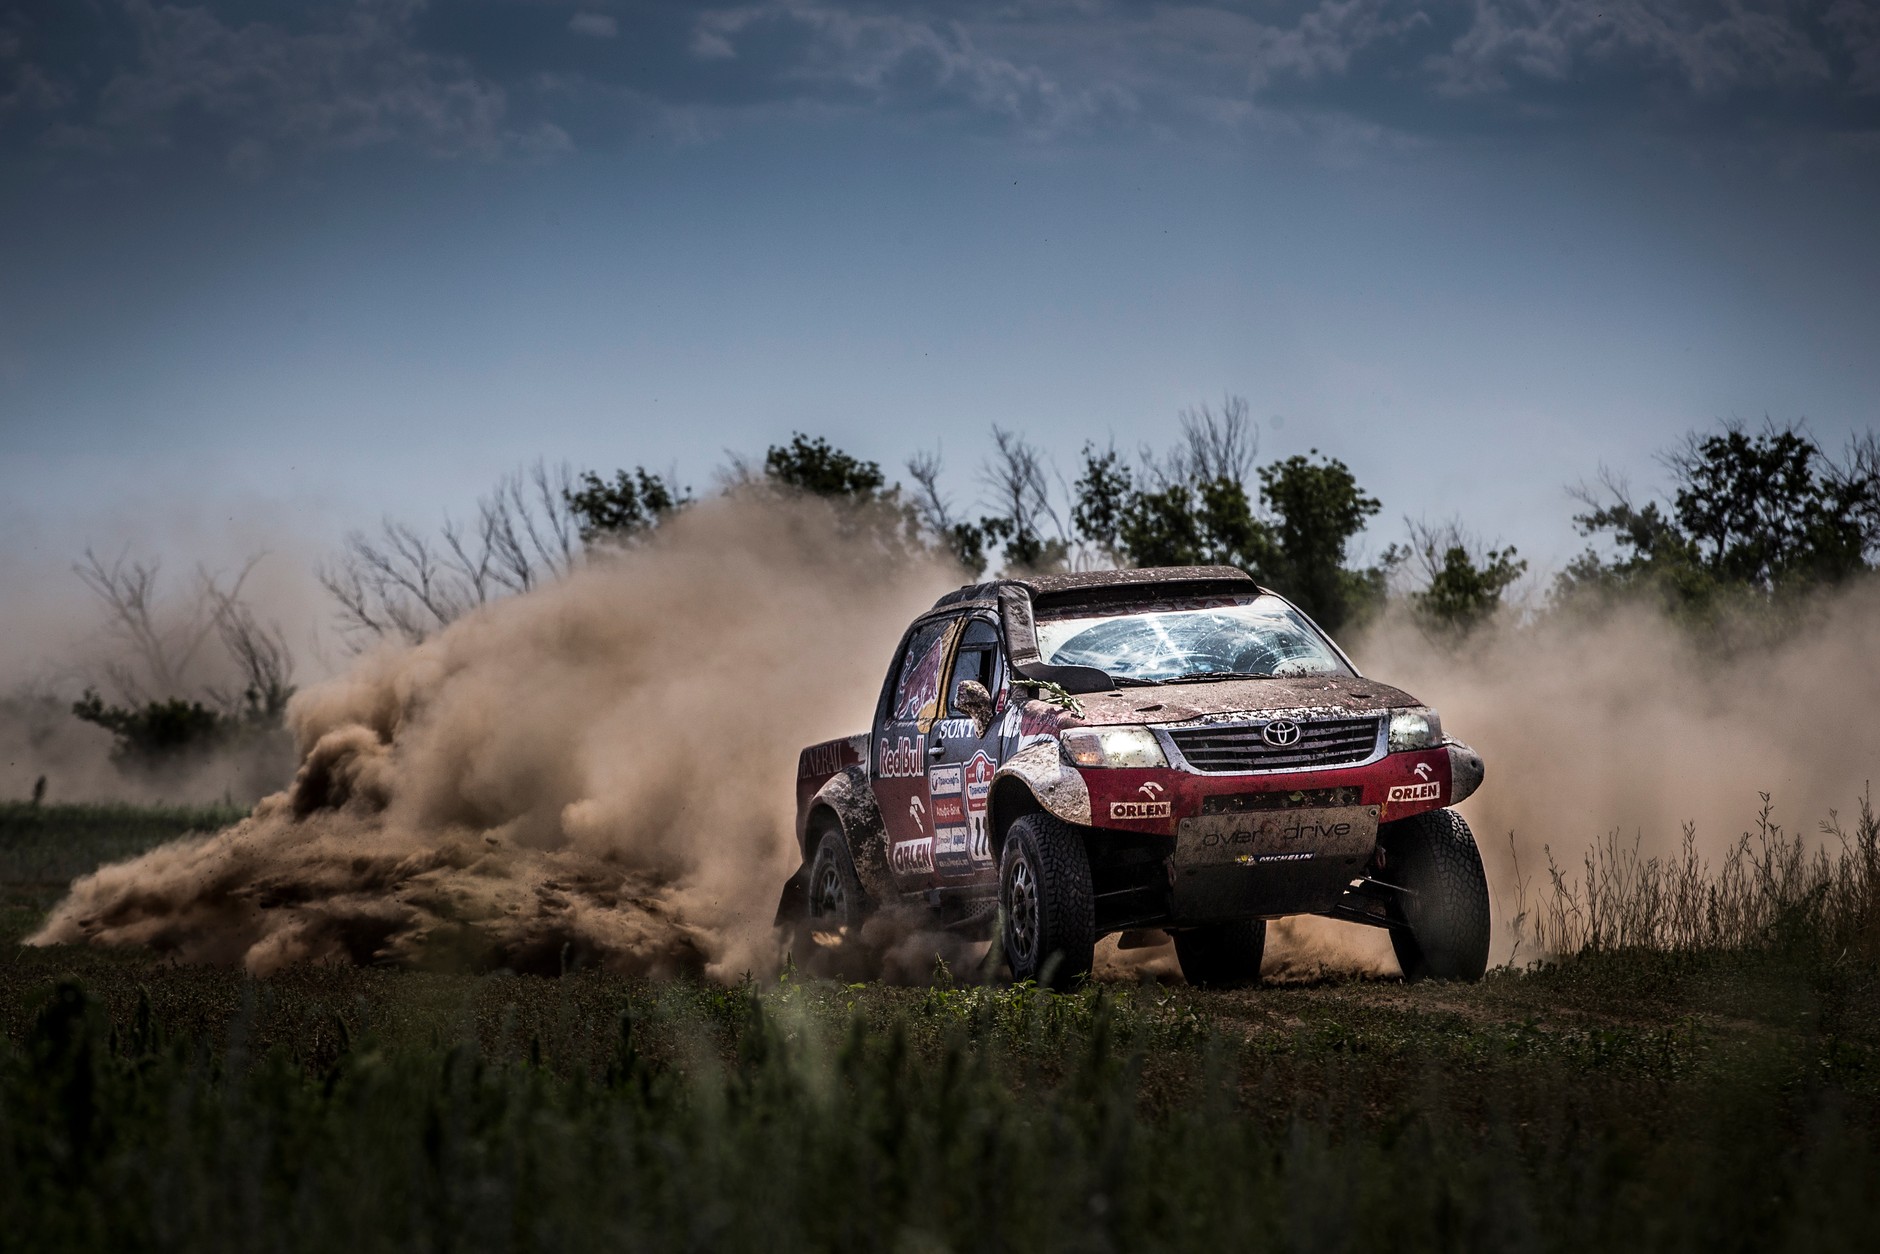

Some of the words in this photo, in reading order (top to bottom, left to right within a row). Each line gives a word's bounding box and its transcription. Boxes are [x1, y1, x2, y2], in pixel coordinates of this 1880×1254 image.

[939, 719, 975, 739] SONY
[880, 737, 902, 778] Red
[901, 734, 925, 777] Bull
[1391, 784, 1438, 800] ORLEN
[1113, 804, 1167, 817] ORLEN
[1202, 827, 1264, 847] over
[1283, 821, 1351, 841] drive
[895, 842, 932, 873] ORLEN
[1259, 853, 1313, 862] MICHELIN
